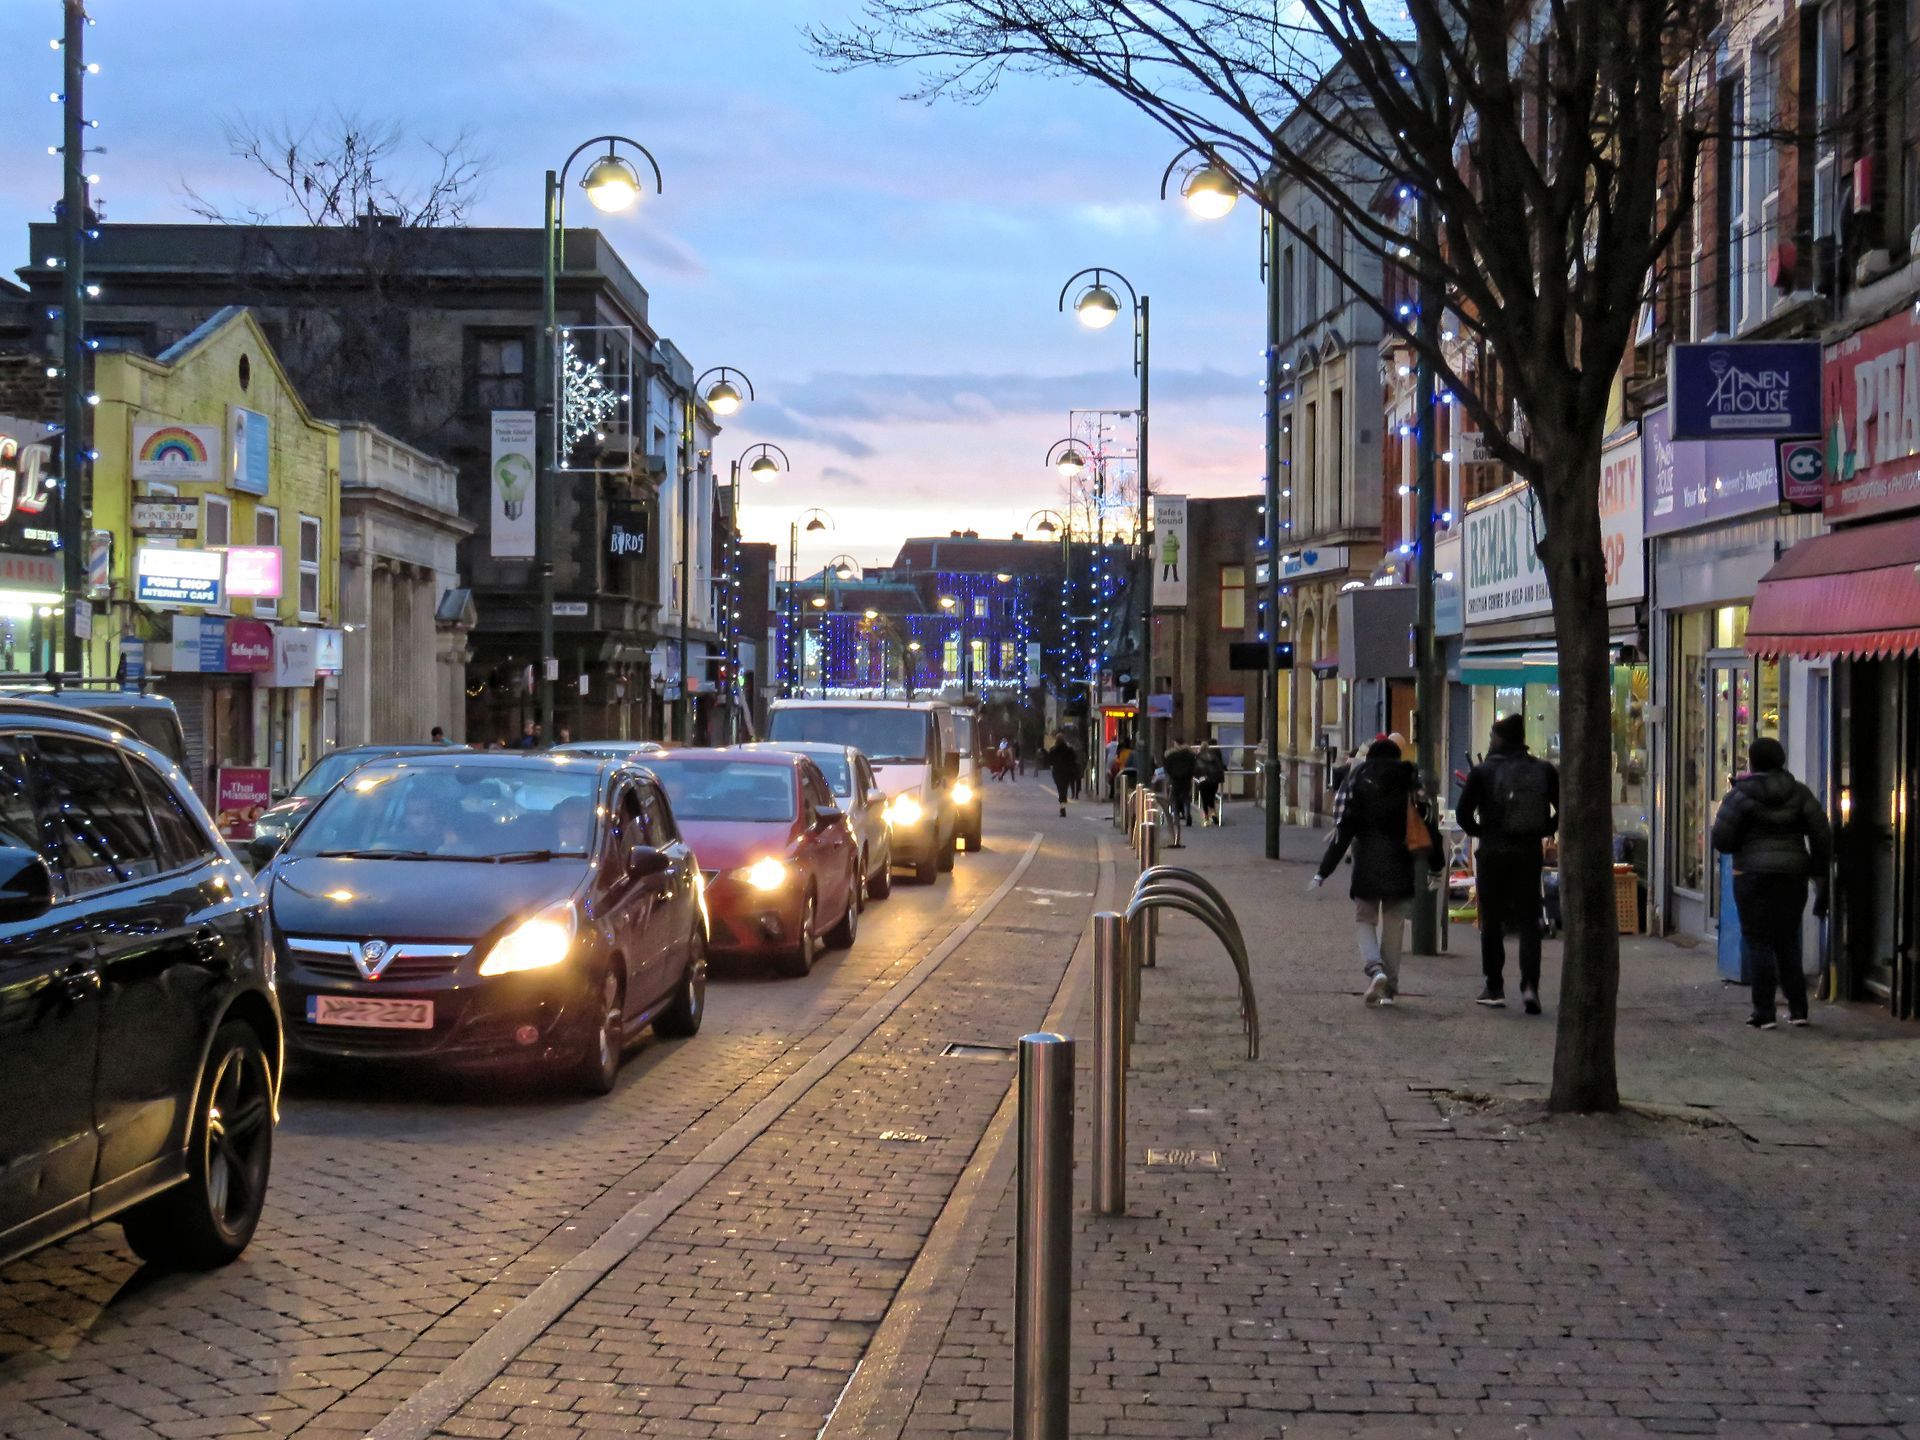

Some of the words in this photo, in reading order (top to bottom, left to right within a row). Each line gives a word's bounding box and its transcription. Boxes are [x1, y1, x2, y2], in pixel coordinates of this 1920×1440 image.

[1745, 466, 1773, 494] hospice
[137, 511, 165, 520] FONE
[167, 511, 195, 521] SHOP
[1158, 507, 1176, 516] Safe
[1157, 516, 1184, 526] Sound
[1470, 503, 1518, 589] REMAR
[147, 576, 178, 588] FONE
[180, 578, 212, 590] SHOP
[142, 587, 188, 599] INTERNET
[189, 590, 215, 601] CAFÉ
[230, 782, 254, 792] Thai
[222, 790, 268, 803] Massage
